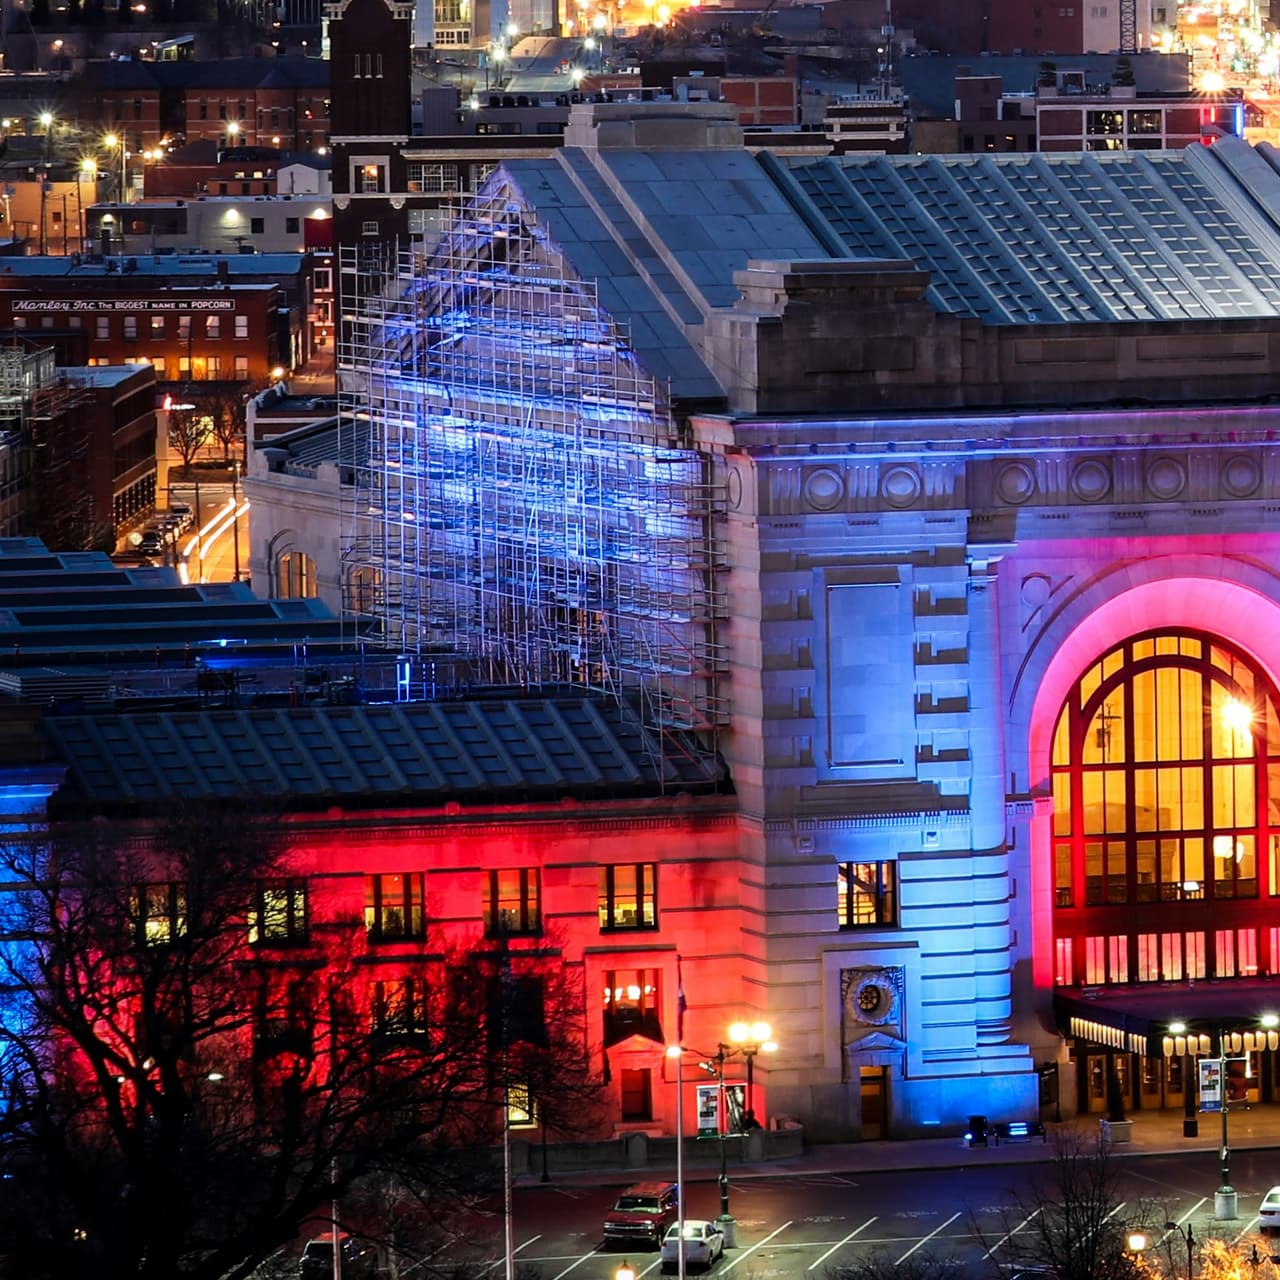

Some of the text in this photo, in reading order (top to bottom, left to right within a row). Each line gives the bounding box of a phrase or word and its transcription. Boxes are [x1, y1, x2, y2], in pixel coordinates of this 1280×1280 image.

[14, 300, 70, 312] Manley
[73, 300, 96, 310] Inc
[98, 301, 113, 309] The
[114, 301, 148, 309] BIGGEST
[191, 301, 231, 309] POPCORN
